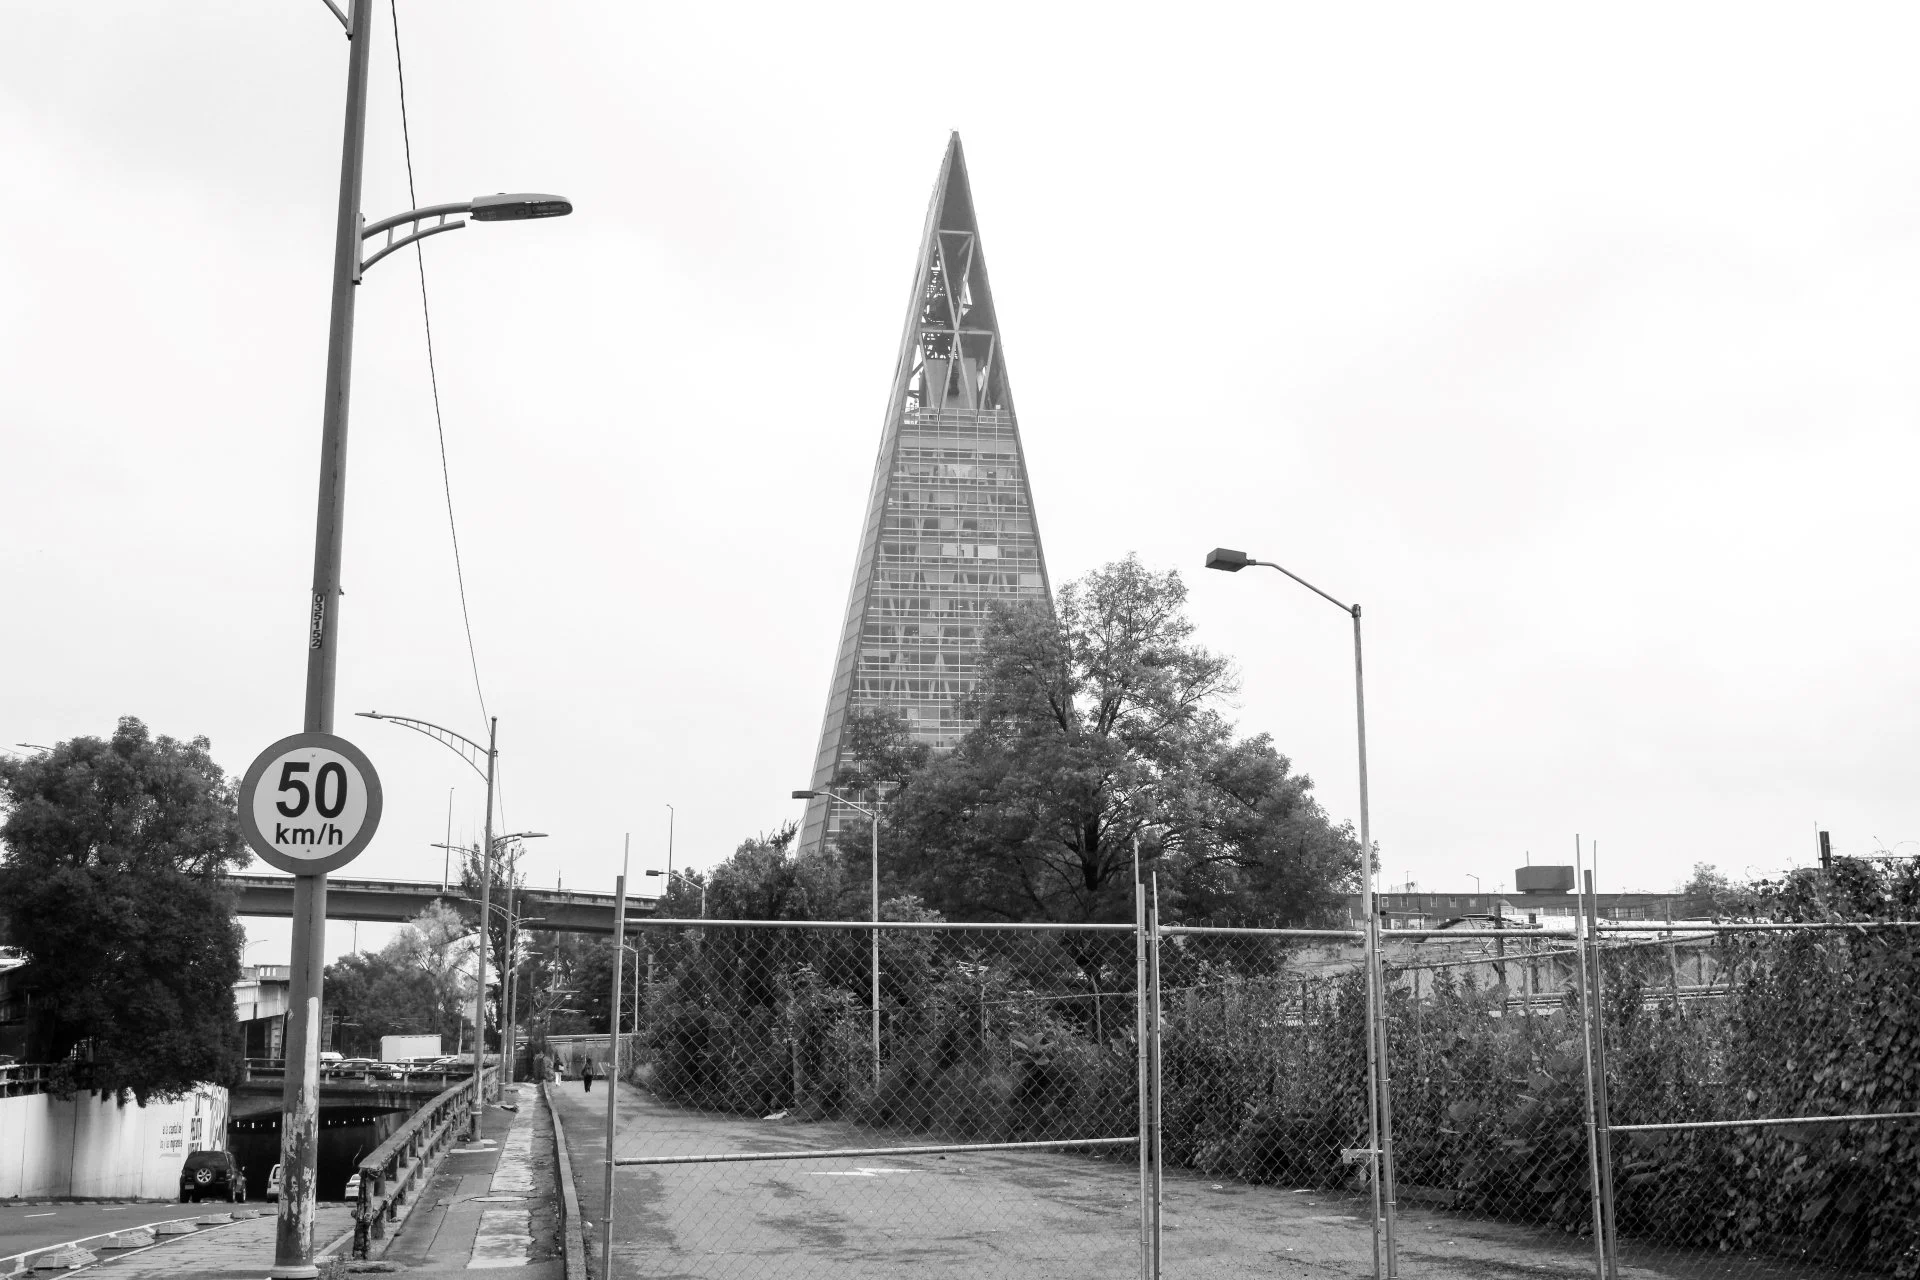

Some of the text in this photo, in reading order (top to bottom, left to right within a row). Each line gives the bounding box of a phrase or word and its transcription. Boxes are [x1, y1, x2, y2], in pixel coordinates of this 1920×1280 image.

[312, 594, 323, 648] 035152
[276, 761, 348, 818] 50
[275, 822, 343, 845] km/h
